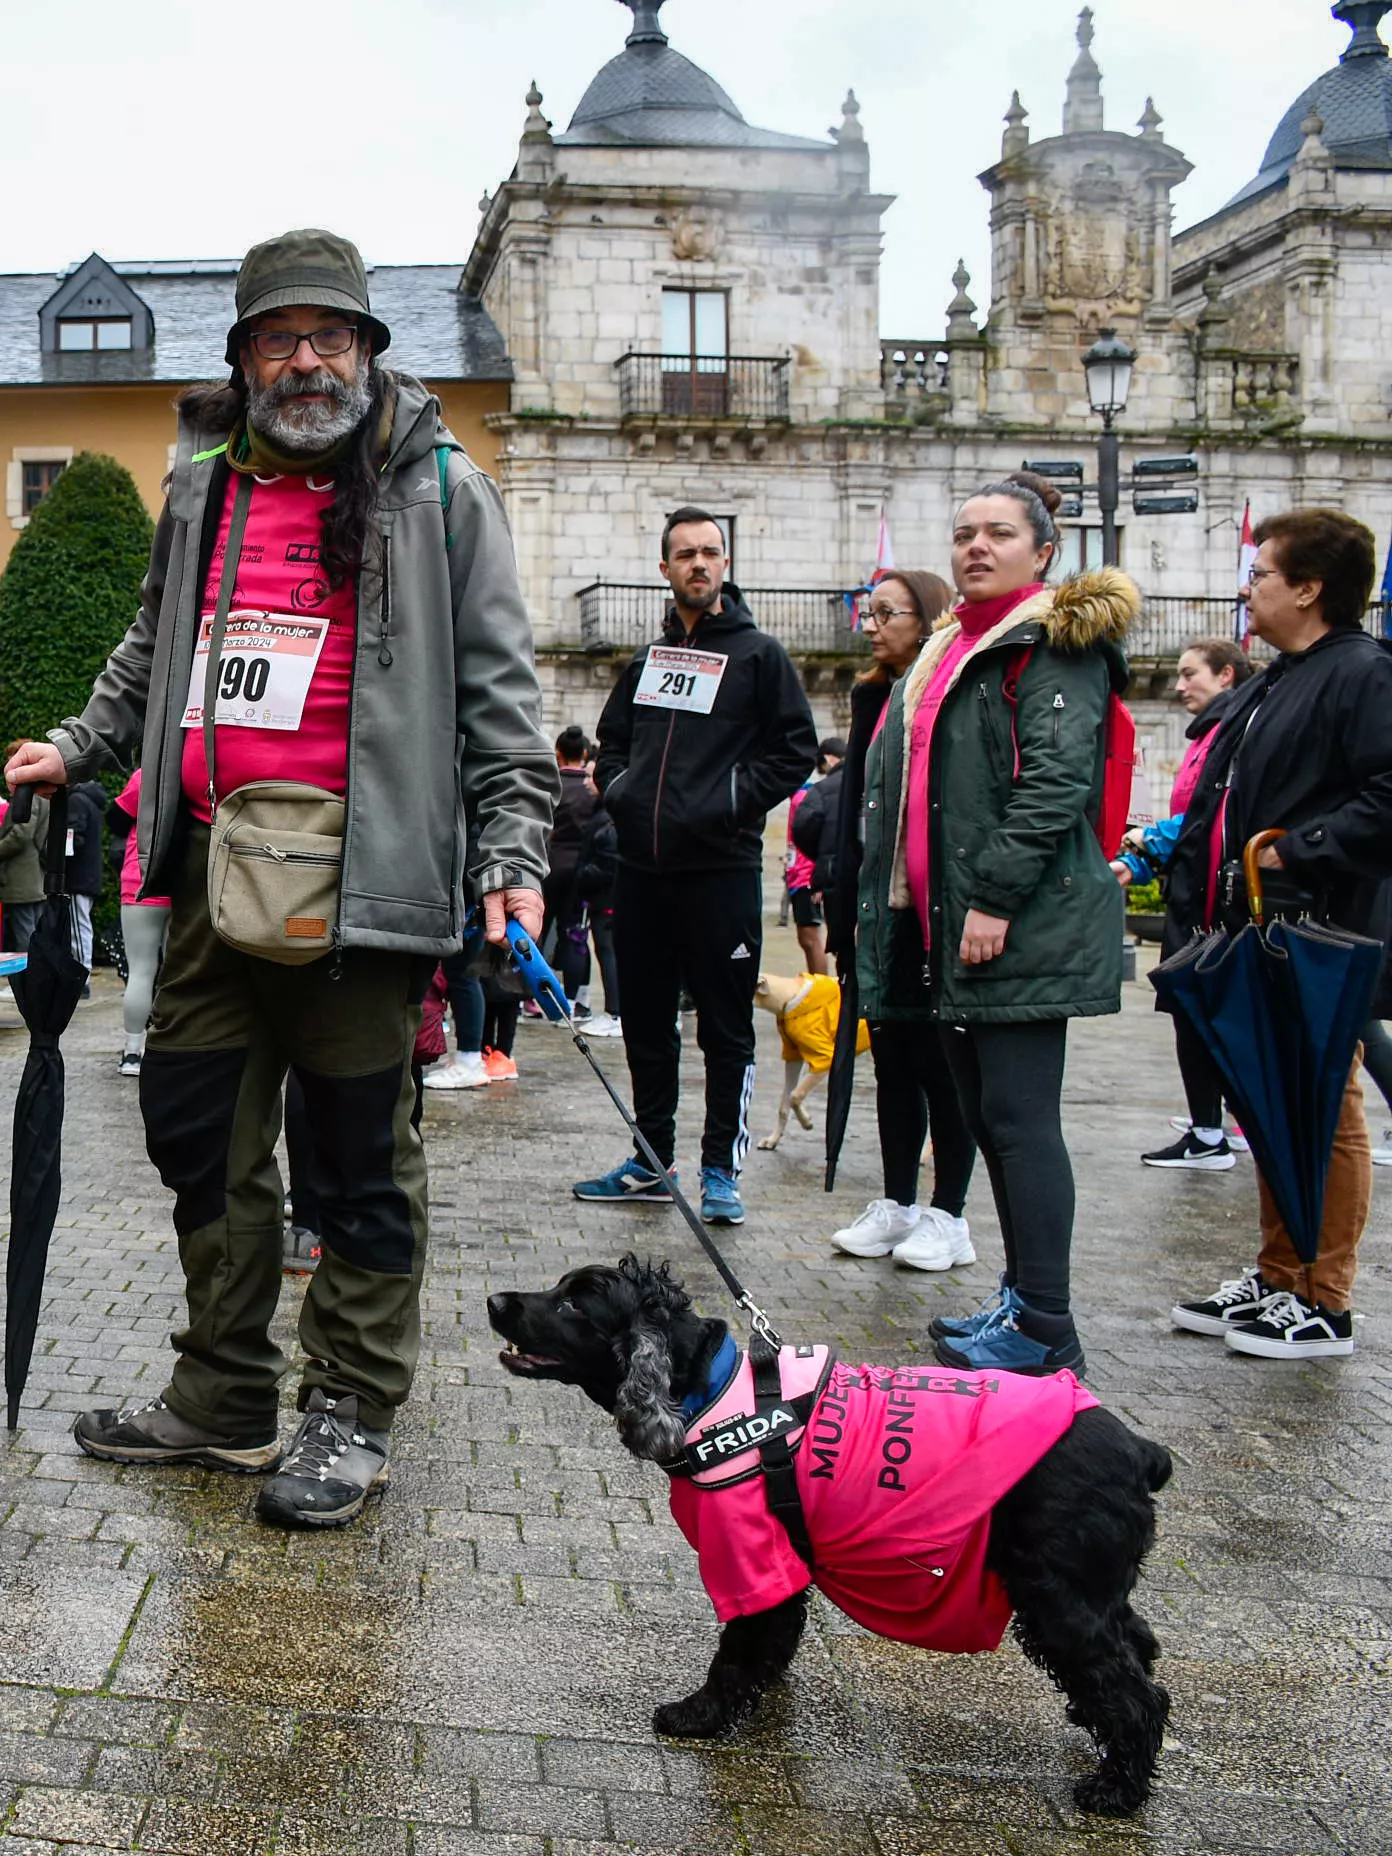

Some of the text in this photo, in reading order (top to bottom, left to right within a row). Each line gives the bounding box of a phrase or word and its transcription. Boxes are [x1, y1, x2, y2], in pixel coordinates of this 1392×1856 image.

[242, 620, 258, 631] de
[260, 622, 271, 633] la
[273, 626, 314, 640] mujer
[247, 636, 271, 648] 2024
[658, 672, 697, 697] 291
[696, 1409, 793, 1461] FRIDA
